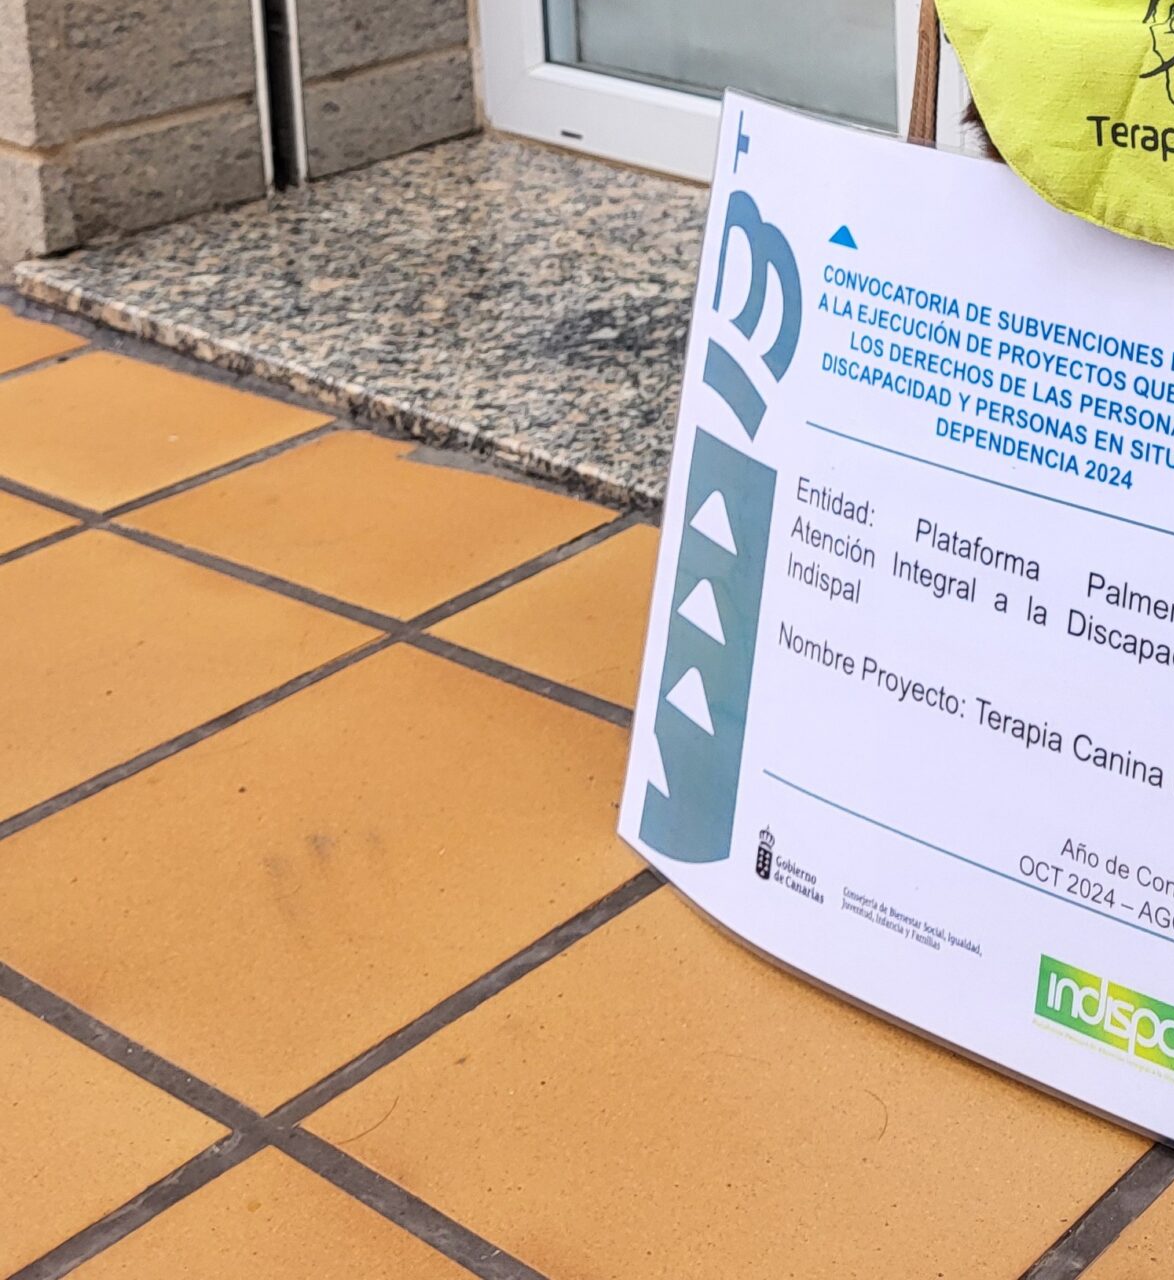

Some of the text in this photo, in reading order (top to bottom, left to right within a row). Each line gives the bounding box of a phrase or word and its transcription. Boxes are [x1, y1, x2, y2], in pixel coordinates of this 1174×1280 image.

[818, 292, 828, 312] A
[833, 296, 852, 319] LA
[858, 304, 960, 349] EJECUCIÓN
[967, 333, 992, 357] DE
[998, 342, 1126, 391] PROYECTOS
[824, 265, 959, 318] CONVOCATORIA
[966, 302, 992, 326] DE
[998, 310, 1163, 368] SUBVENCIONES
[822, 352, 952, 407] DISCAPACIDAD
[959, 392, 971, 412] Y
[976, 398, 1087, 445] PERSONAS
[1095, 429, 1123, 455] EN
[850, 331, 883, 357] LOS
[890, 343, 993, 388] DERECHOS
[1000, 373, 1026, 397] DE
[1033, 382, 1072, 409] LAS
[936, 417, 1133, 490] DEPENDENCIA 2024
[797, 476, 874, 527] Entidad:
[916, 518, 1039, 581] Plataforma
[788, 552, 860, 603] Indispal
[791, 516, 875, 568] Atención
[893, 551, 976, 602] Integral
[994, 593, 1007, 613] a
[1027, 595, 1047, 626] la
[779, 621, 854, 675] Nombre
[862, 656, 965, 718] Proyecto:
[976, 697, 1062, 753] Terapia
[1073, 734, 1163, 788] Canina
[774, 871, 825, 904] de Canarias
[776, 855, 817, 885] Gobierno
[1020, 856, 1063, 886] OCT
[1067, 874, 1115, 908] 2024
[1061, 838, 1099, 868] Año
[1106, 856, 1129, 879] de
[876, 913, 904, 934] Infancia
[912, 930, 940, 950] Familias
[880, 902, 888, 913] de
[890, 907, 921, 930] Bienestar
[924, 921, 946, 941] Social,
[948, 932, 983, 957] Igualdad,
